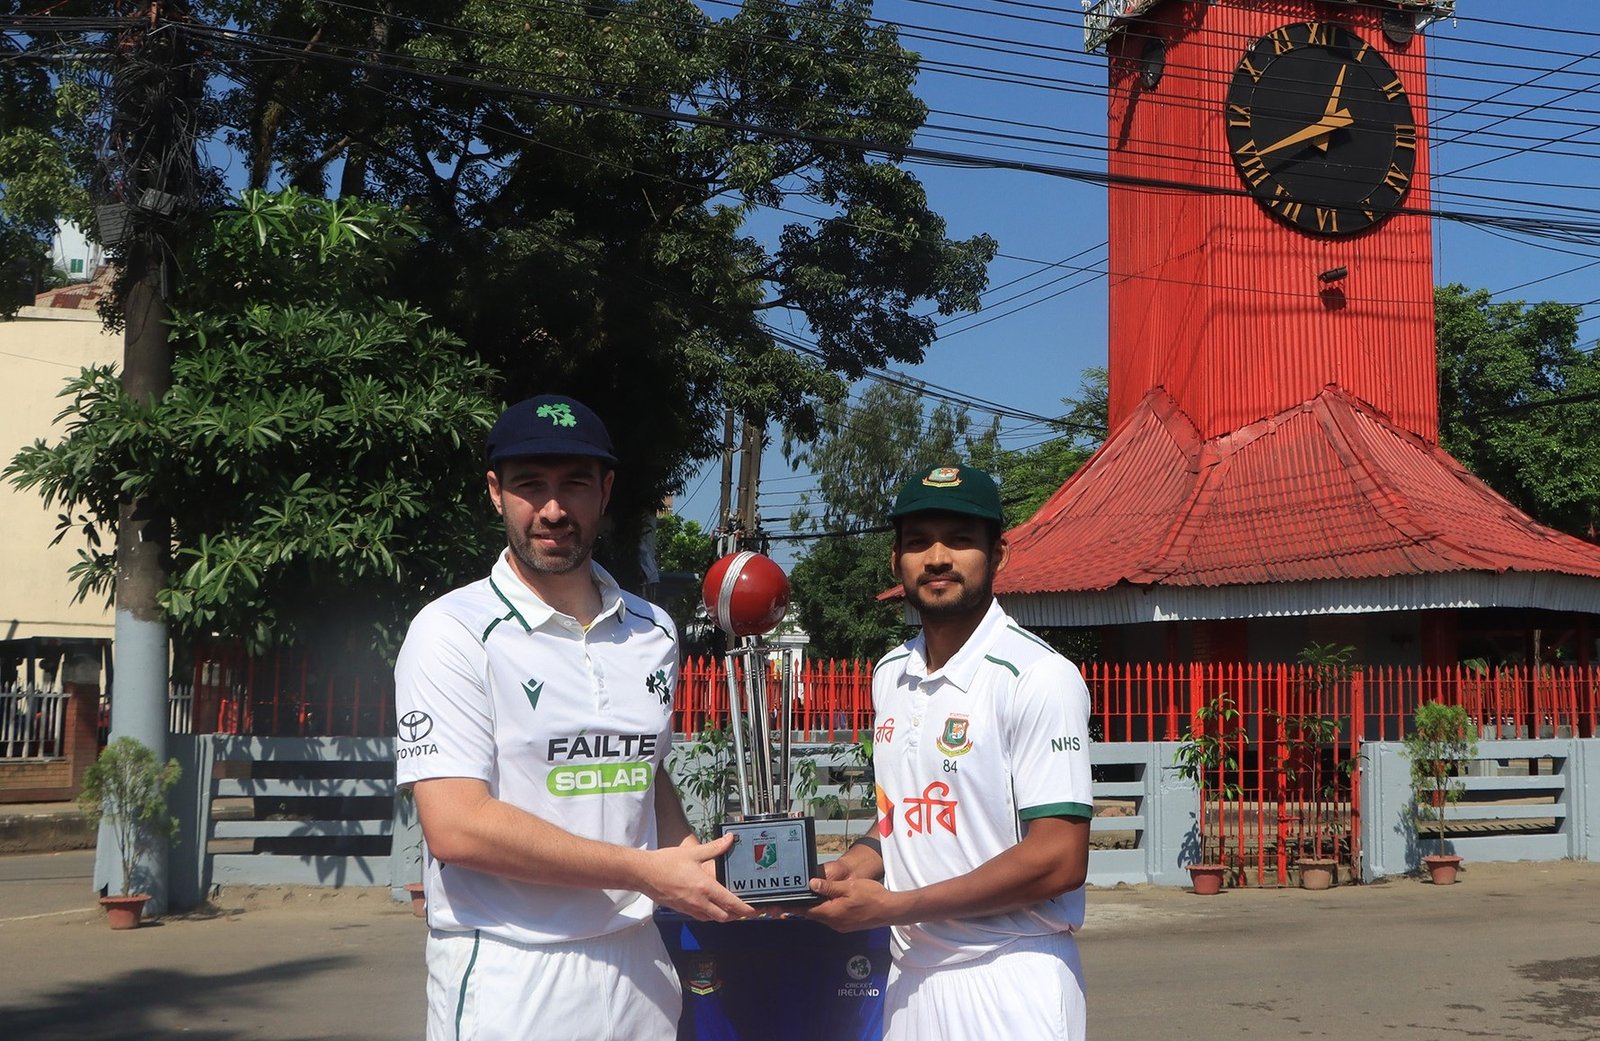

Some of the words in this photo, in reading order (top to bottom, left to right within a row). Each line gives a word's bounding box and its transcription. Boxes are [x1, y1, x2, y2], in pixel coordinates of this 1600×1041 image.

[547, 729, 657, 761] FÁILTE
[1051, 736, 1081, 752] NHS
[942, 758, 958, 773] 84
[555, 767, 648, 791] SOLAR
[903, 781, 958, 838] রবি
[733, 875, 802, 890] WINNER
[838, 988, 880, 997] IRELAND
